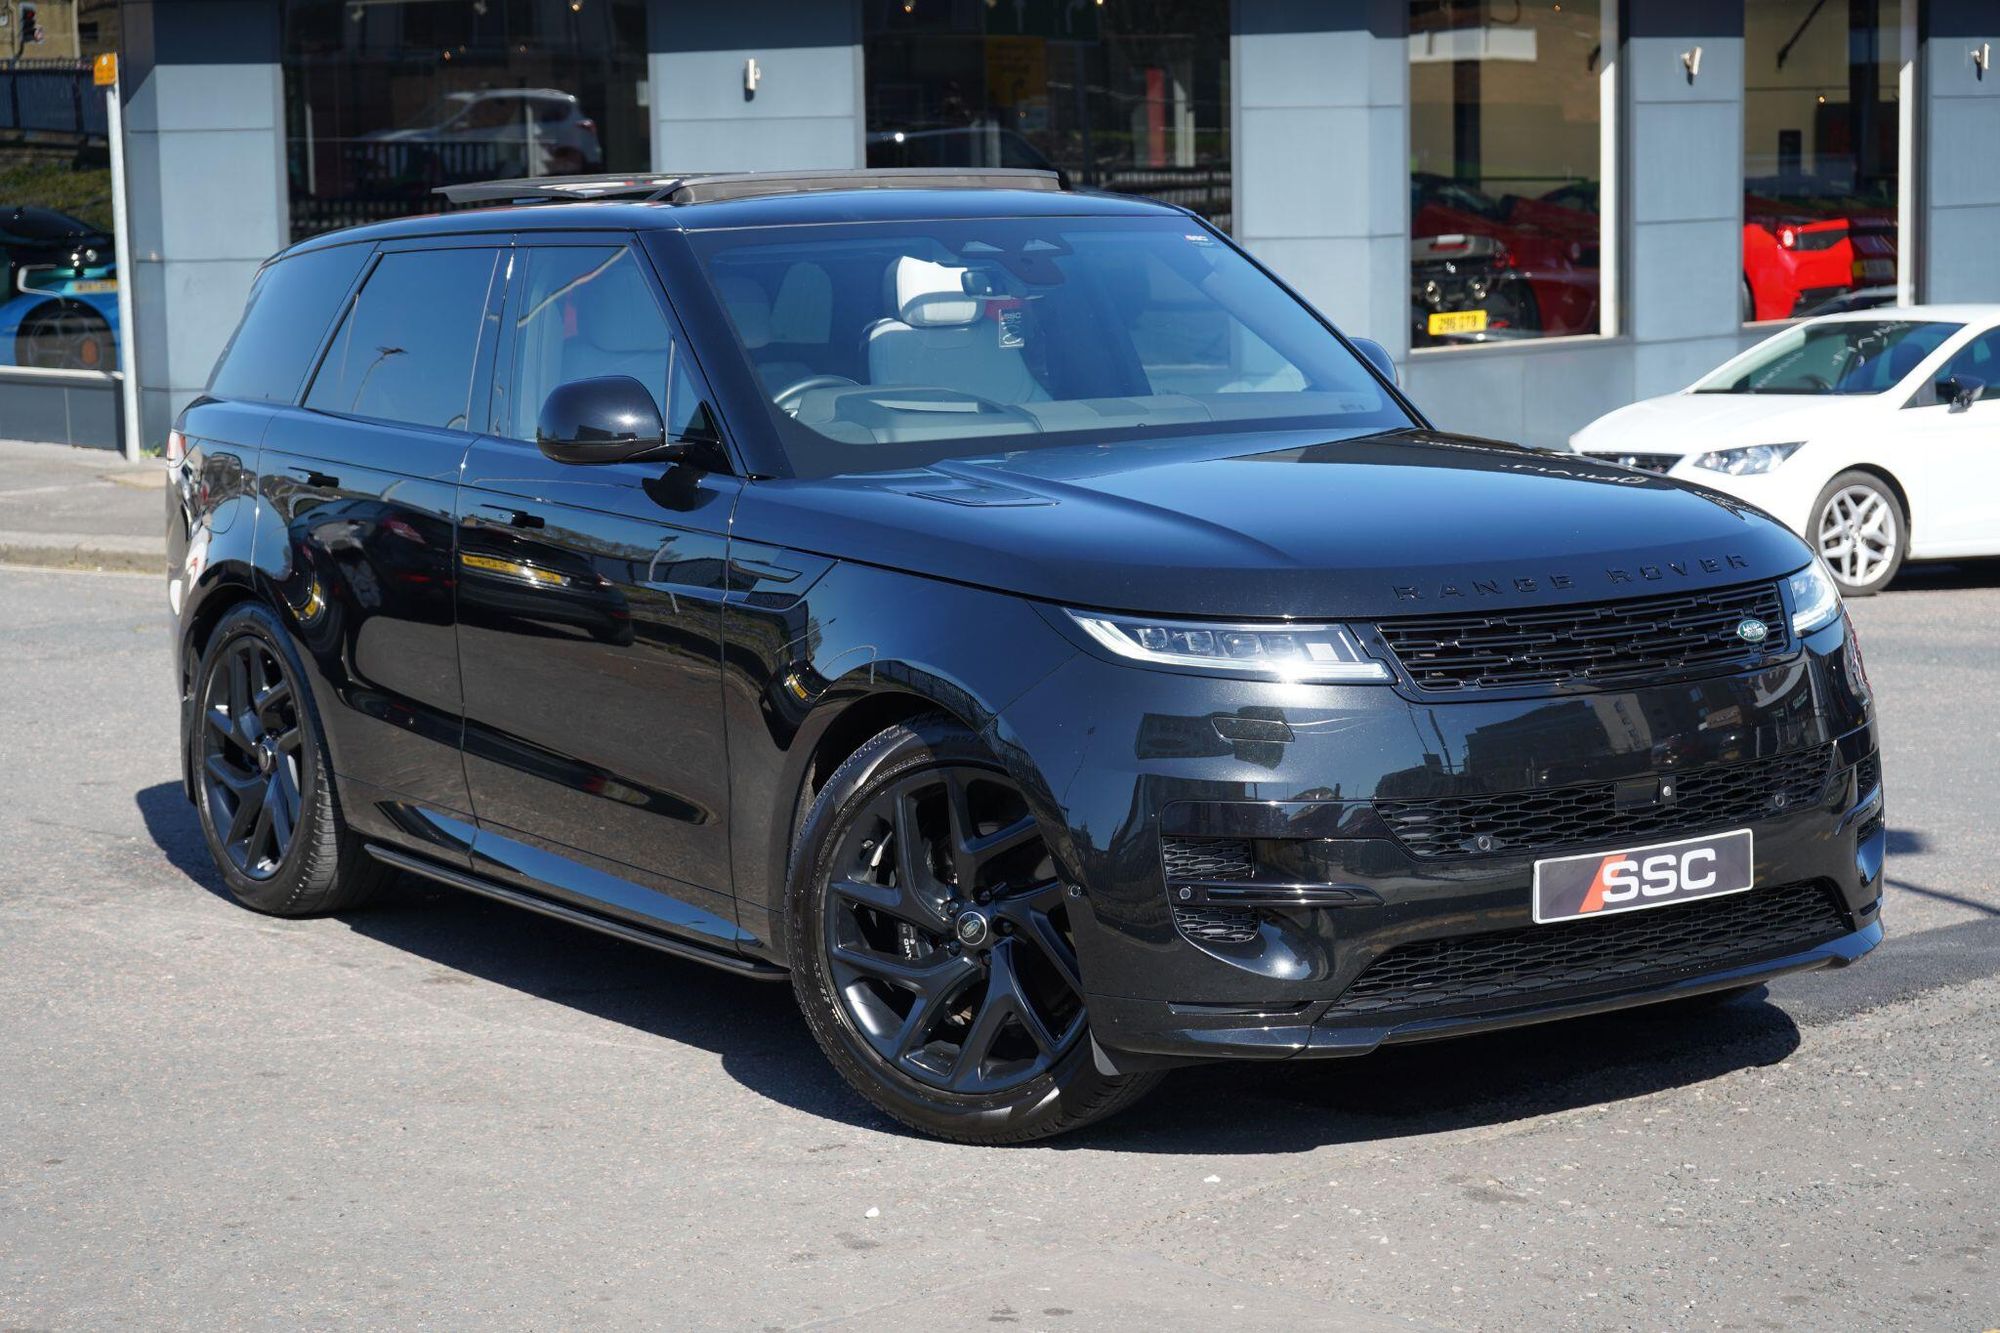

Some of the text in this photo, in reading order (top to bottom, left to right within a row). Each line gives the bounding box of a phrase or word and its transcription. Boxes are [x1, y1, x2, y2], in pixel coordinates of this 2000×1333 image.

[1393, 554, 1750, 601] RANGE ROVER
[1602, 848, 1717, 903] SSC
